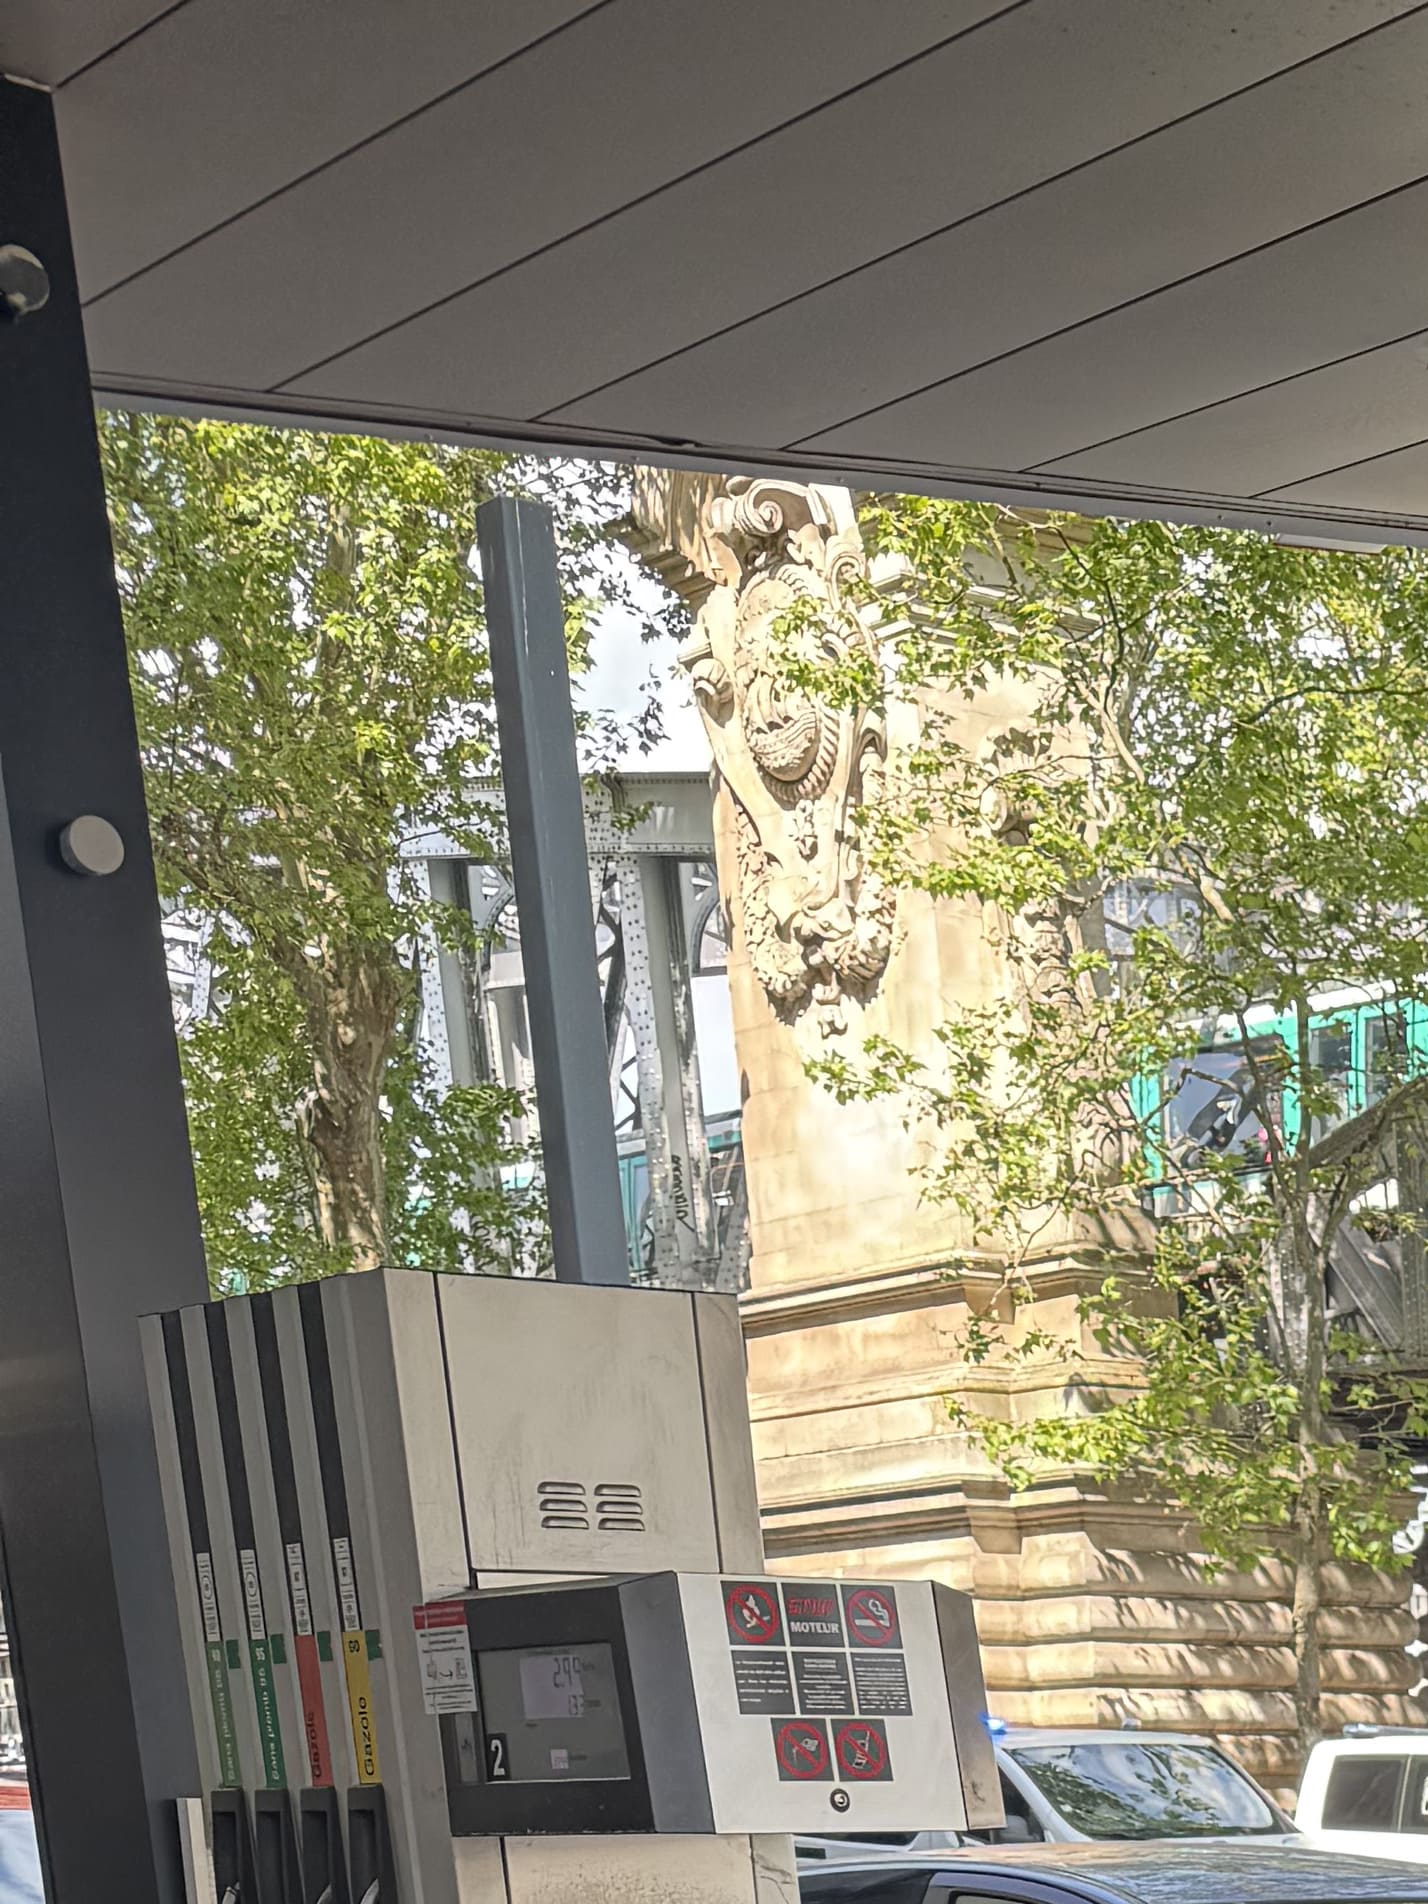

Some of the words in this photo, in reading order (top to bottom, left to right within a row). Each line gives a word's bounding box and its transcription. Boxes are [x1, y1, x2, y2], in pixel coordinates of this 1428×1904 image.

[790, 1621, 839, 1634] MOTEUR
[306, 1711, 322, 1778] Gazole
[358, 1697, 375, 1776] Gazole
[490, 1739, 505, 1776] 2
